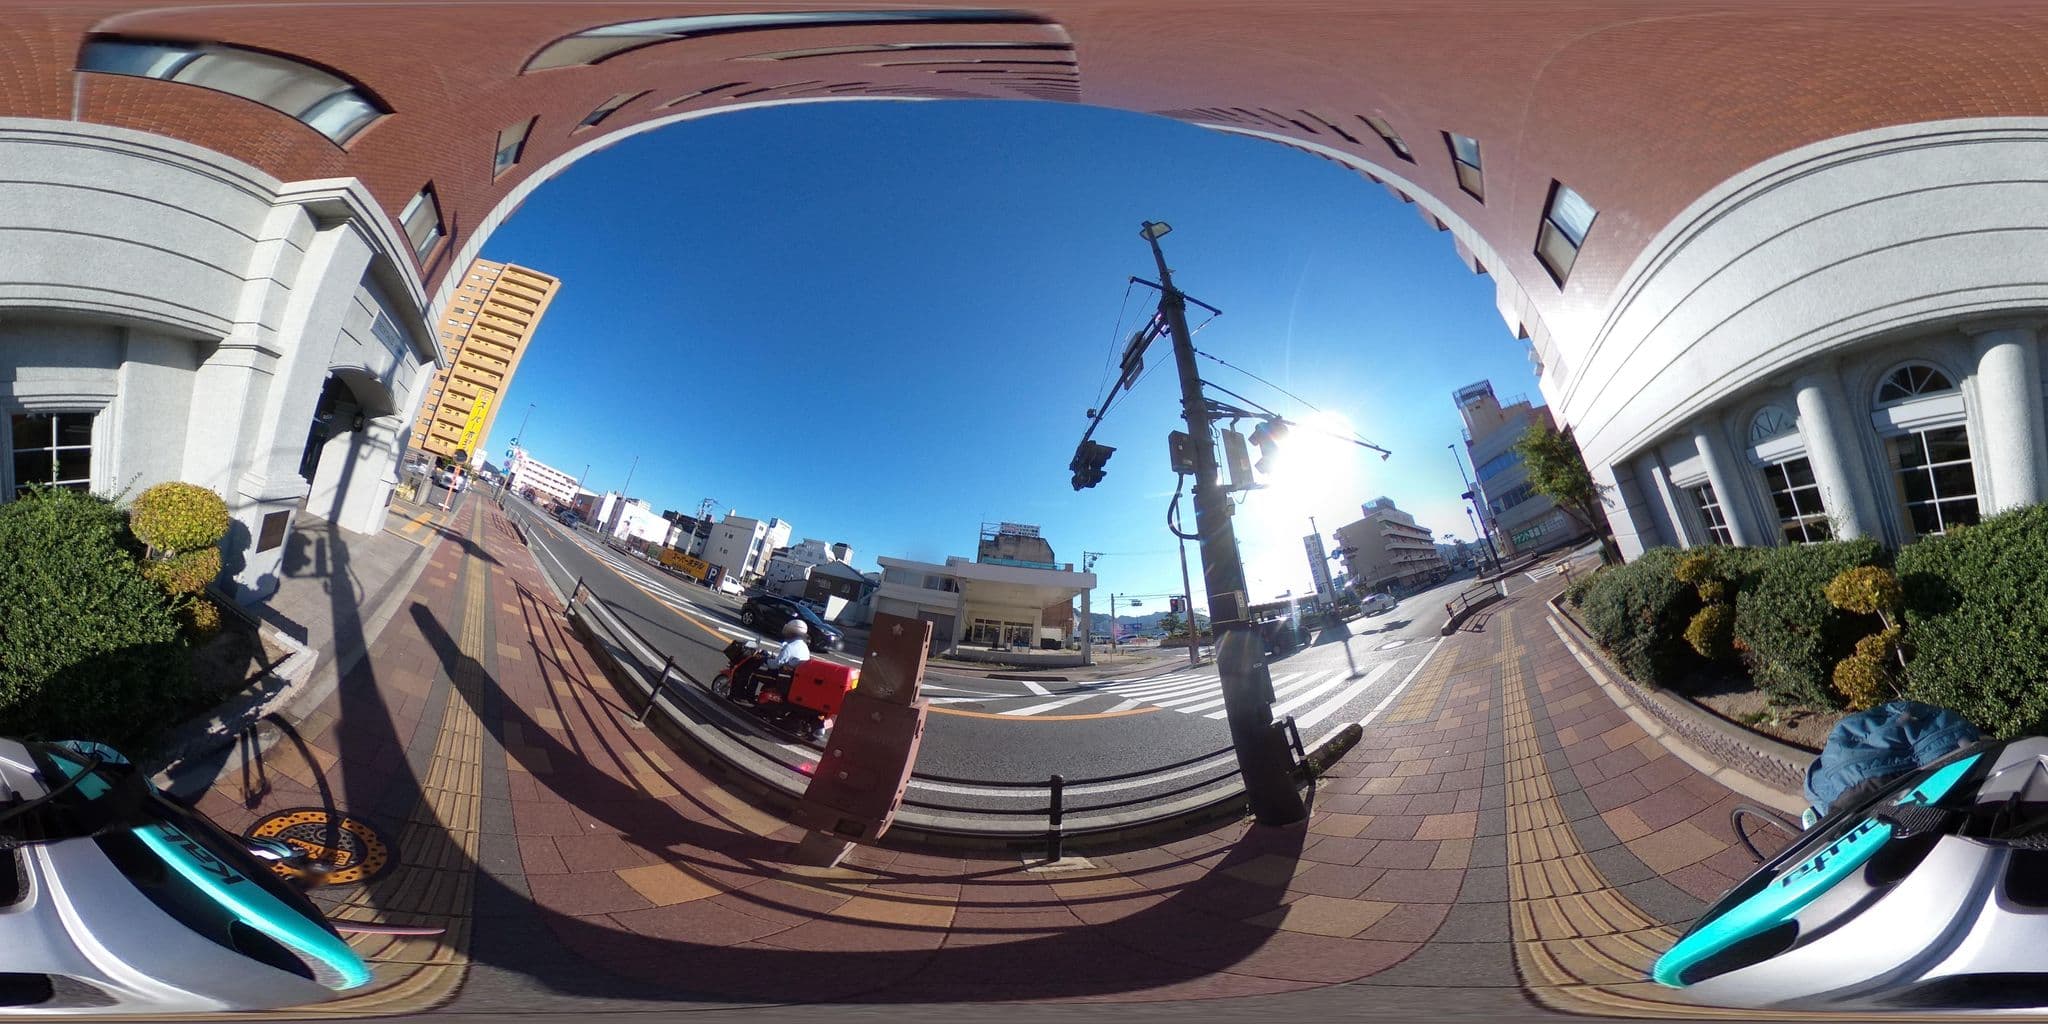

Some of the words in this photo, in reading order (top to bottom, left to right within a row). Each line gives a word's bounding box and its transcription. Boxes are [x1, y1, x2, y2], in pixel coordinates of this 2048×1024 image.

[462, 401, 487, 450] スーパーホテ
[708, 567, 718, 579] P
